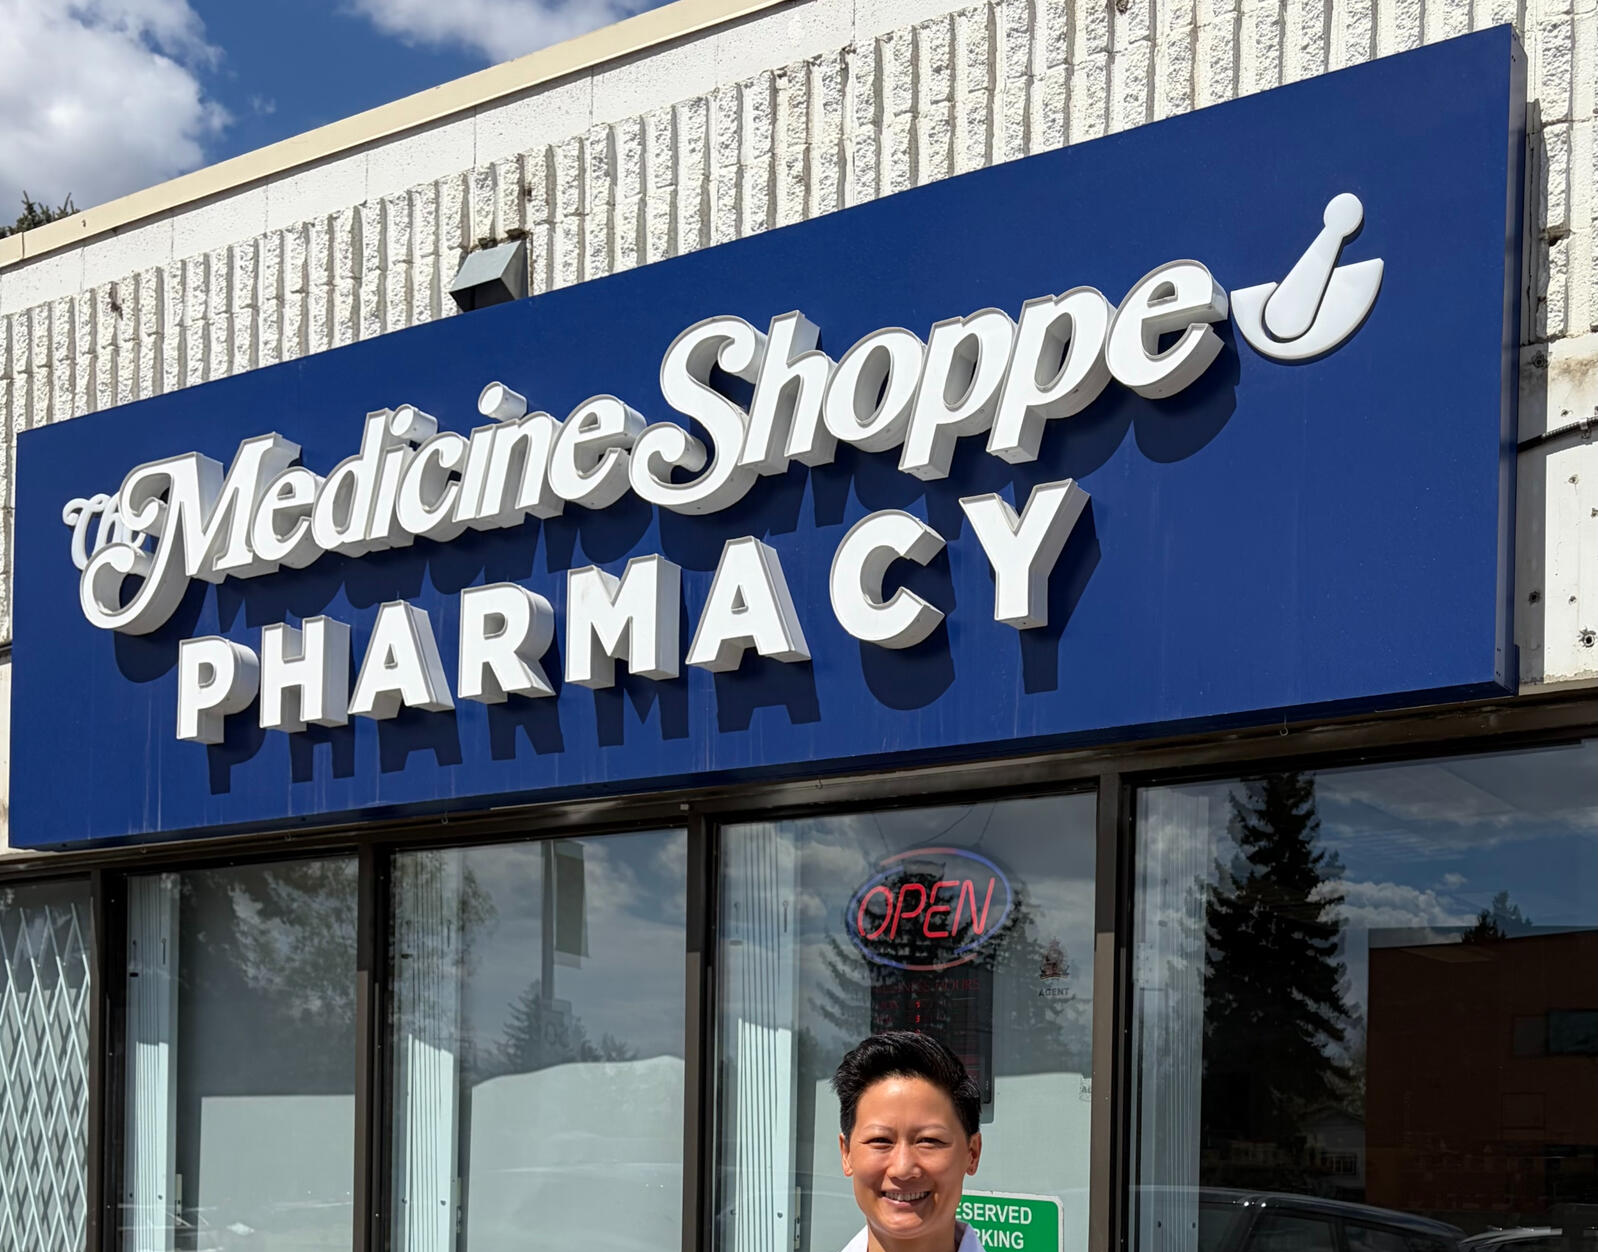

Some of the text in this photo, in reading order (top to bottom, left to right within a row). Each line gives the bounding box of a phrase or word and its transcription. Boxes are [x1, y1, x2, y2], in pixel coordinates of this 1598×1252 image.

[81, 381, 647, 635] Medicine
[629, 258, 1228, 515] Shoppe
[176, 478, 1091, 744] PHARMACY
[857, 877, 996, 940] OPEN
[1038, 986, 1070, 997] AGENT
